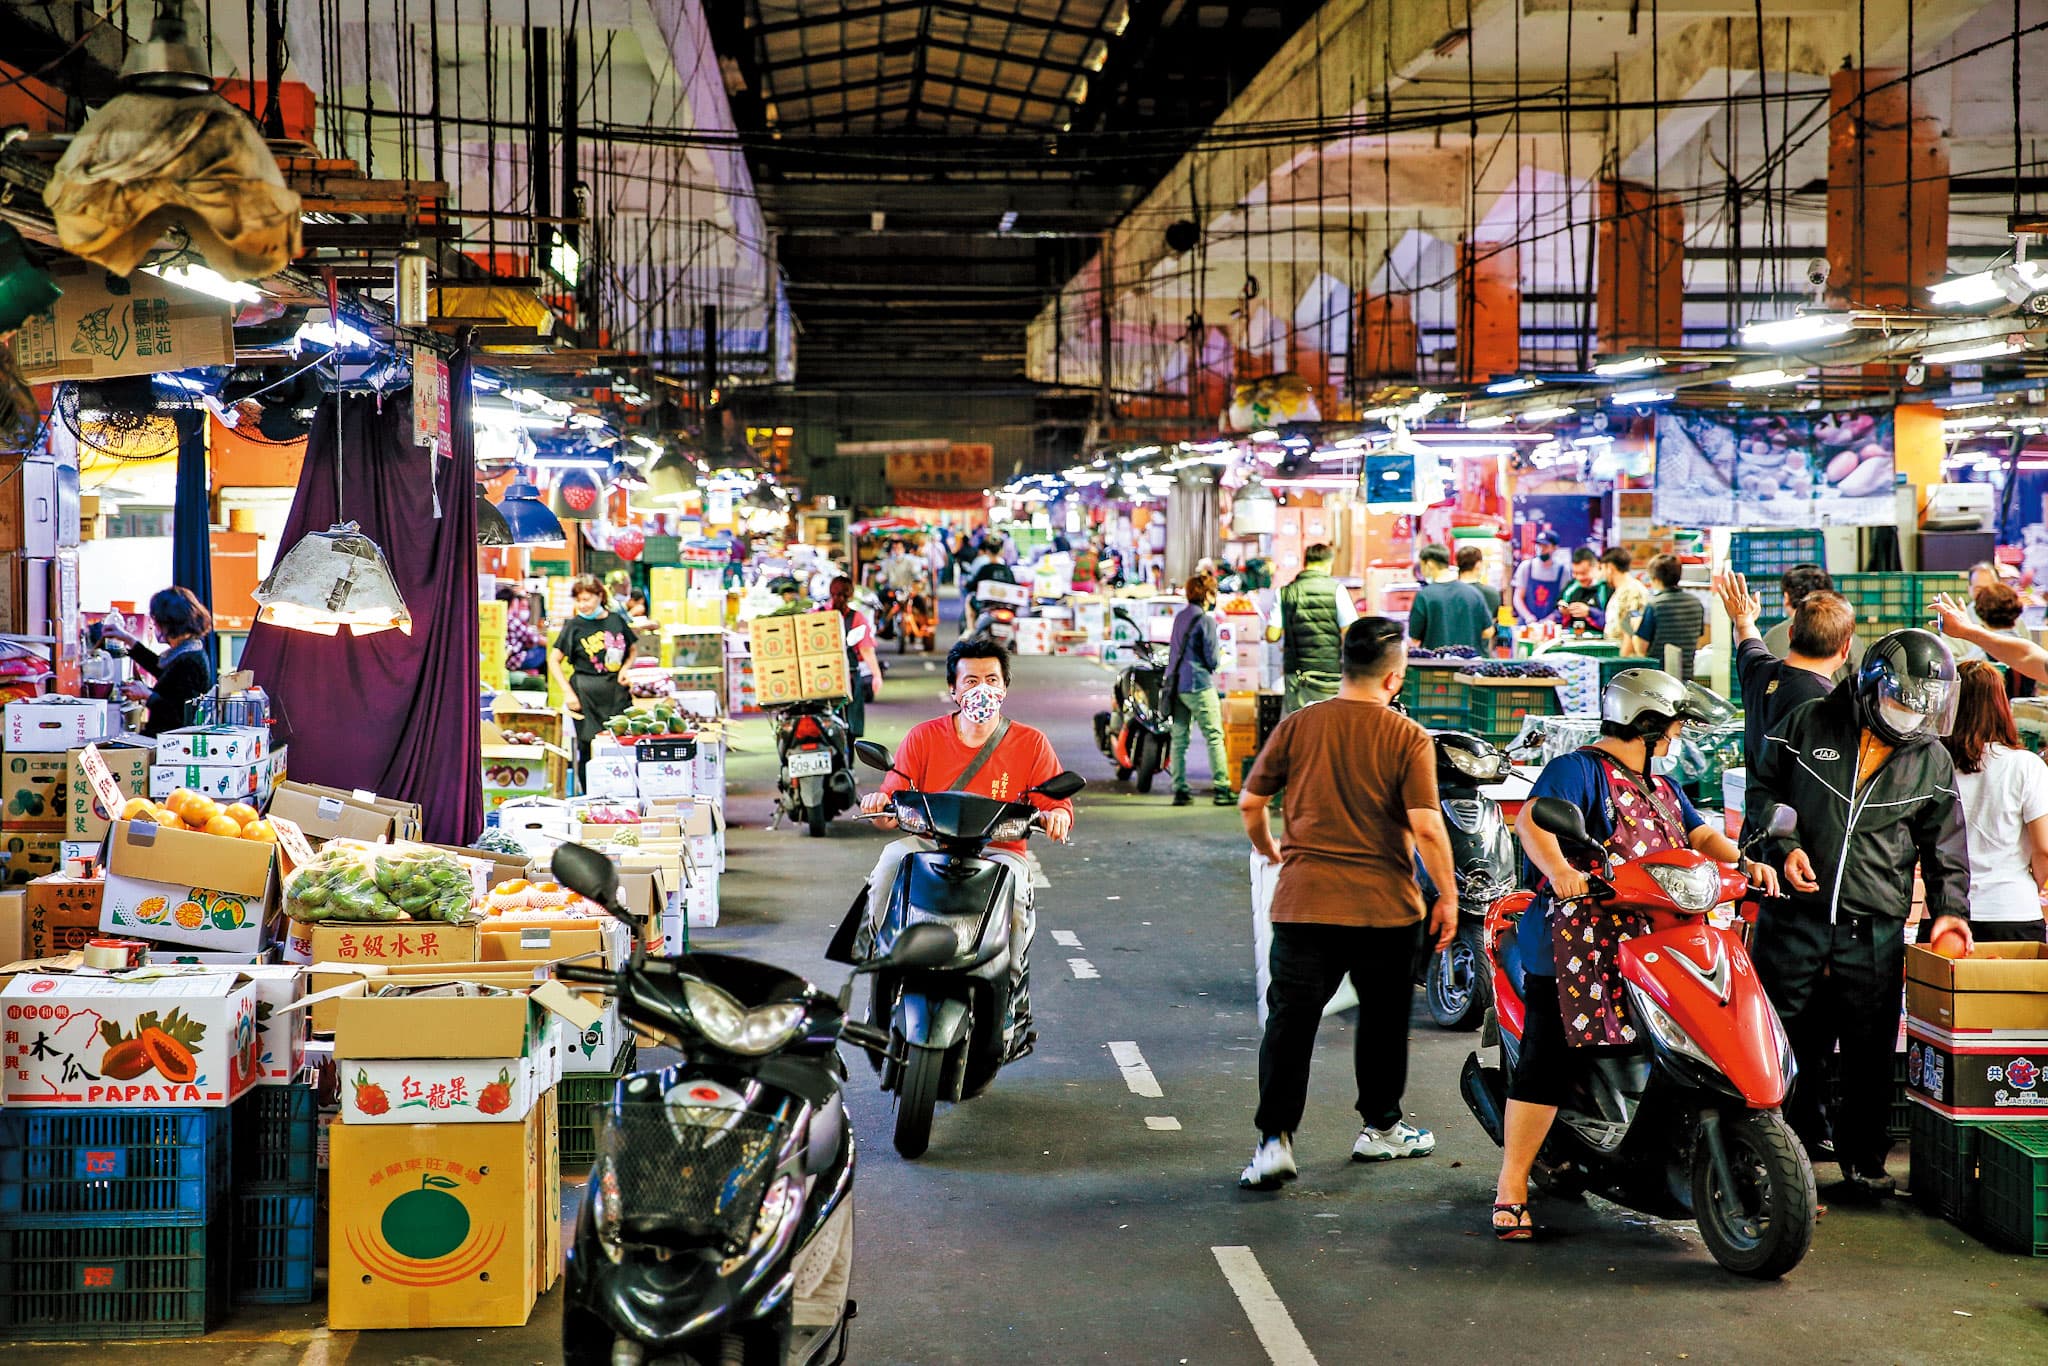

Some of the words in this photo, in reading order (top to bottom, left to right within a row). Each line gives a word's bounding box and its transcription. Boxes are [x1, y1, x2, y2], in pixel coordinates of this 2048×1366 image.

[131, 761, 144, 795] 品質
[337, 932, 440, 959] 高級水果
[29, 1031, 101, 1084] 木瓜
[88, 1085, 201, 1102] PAPAYA
[401, 1075, 469, 1110] 紅龍果
